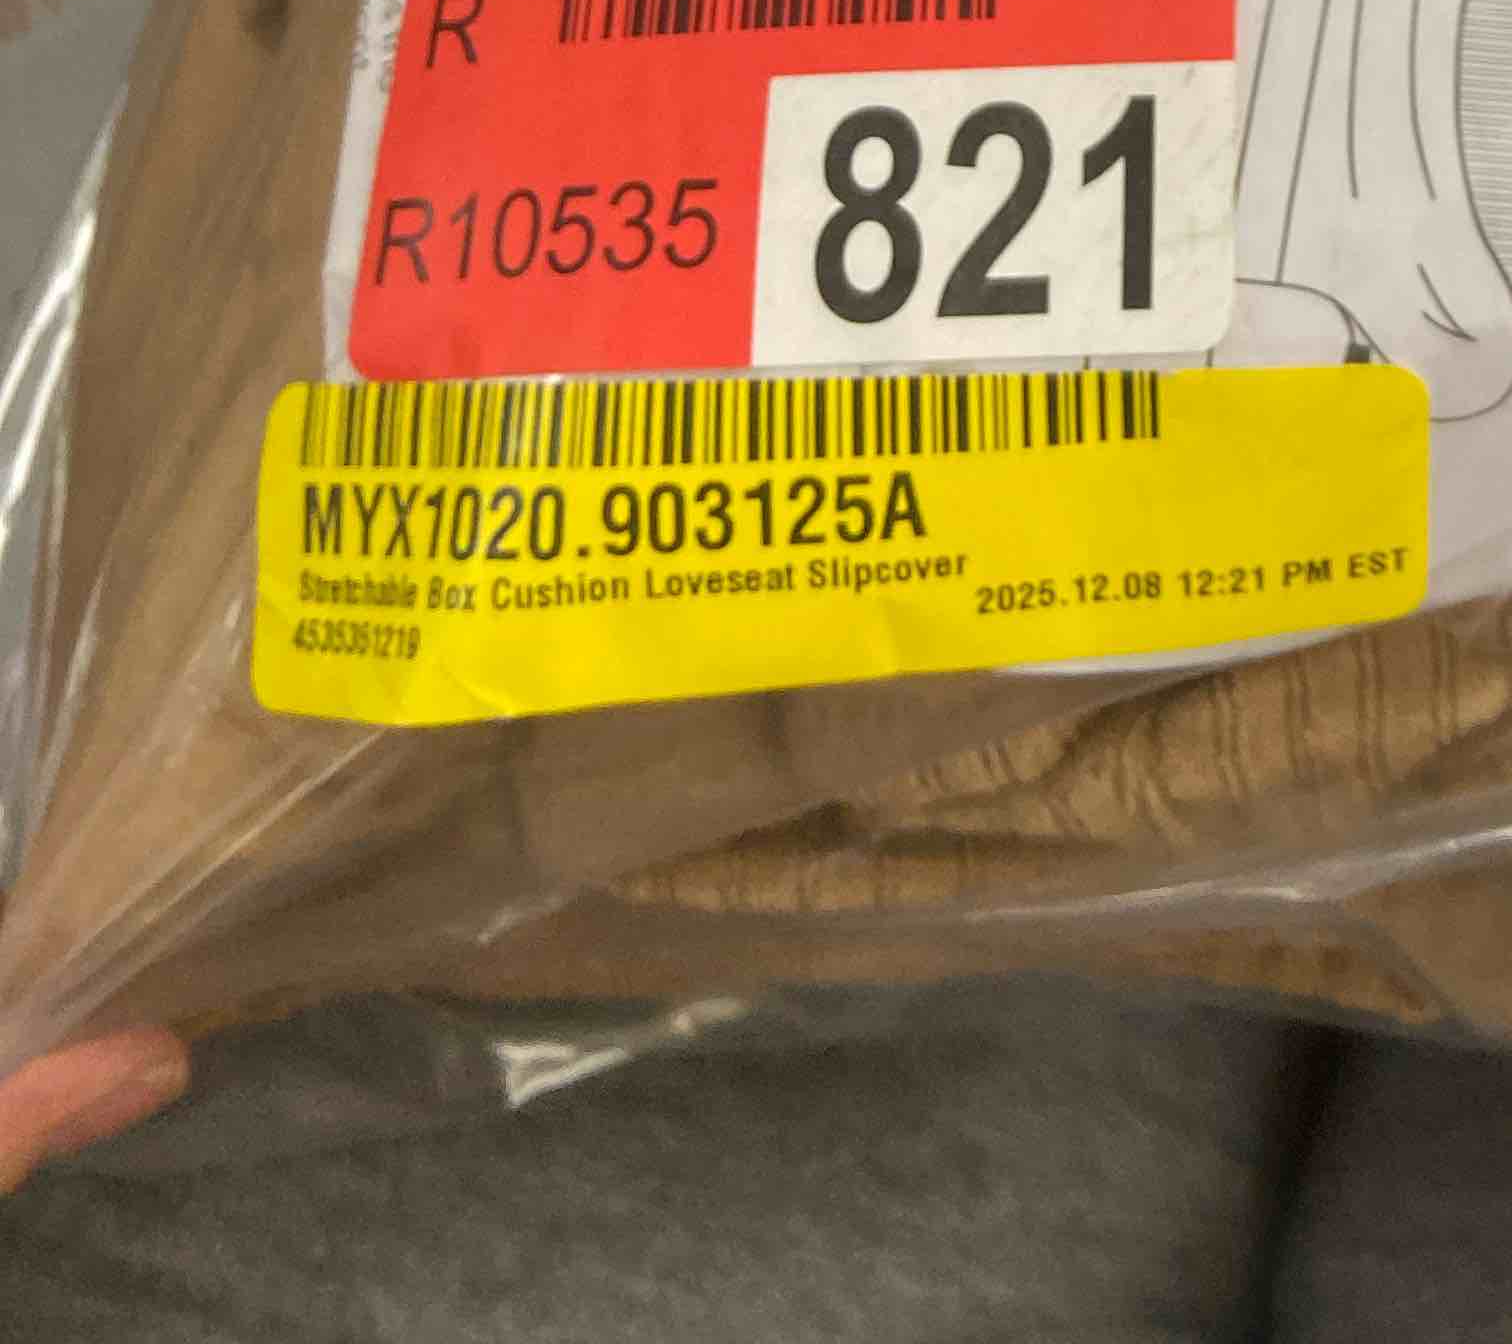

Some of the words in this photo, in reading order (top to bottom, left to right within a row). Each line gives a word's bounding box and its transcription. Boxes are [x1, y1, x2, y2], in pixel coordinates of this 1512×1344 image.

[372, 179, 721, 287] R10535
[813, 93, 1158, 324] 821
[302, 471, 927, 564] MYX1020.903125A
[299, 569, 417, 610] Stretchable
[427, 573, 476, 611] Box
[490, 572, 630, 611] Cushion
[644, 561, 796, 600] Loveseat
[807, 553, 968, 594] Slipcover
[976, 570, 1162, 615] 2025.12.08
[1181, 566, 1266, 600] 12:21
[1282, 557, 1331, 587] PM
[1347, 546, 1409, 578] EST
